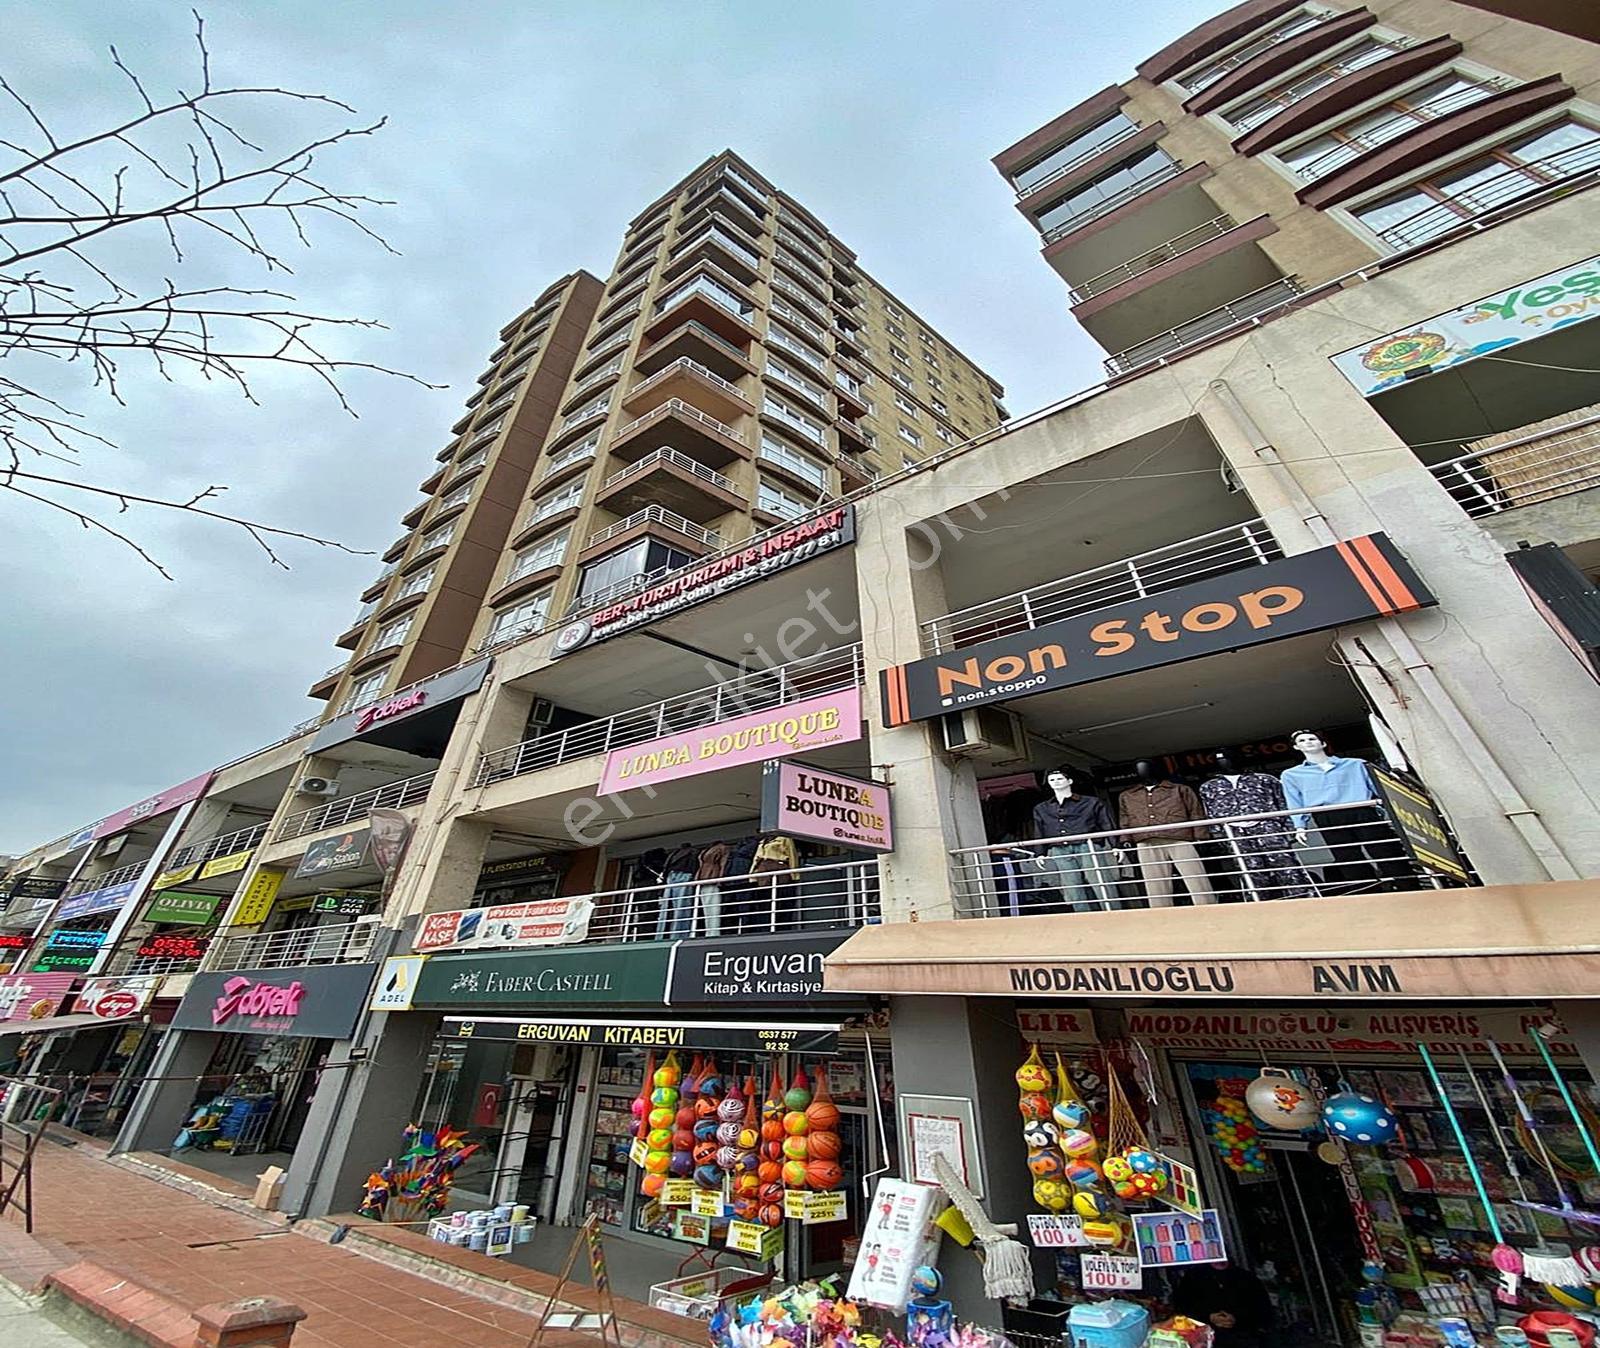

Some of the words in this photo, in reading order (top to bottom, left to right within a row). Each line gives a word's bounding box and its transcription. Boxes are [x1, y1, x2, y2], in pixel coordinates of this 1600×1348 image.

[743, 547, 760, 565] &
[761, 509, 846, 556] İNŞAAT
[718, 566, 758, 588] 0532
[817, 531, 841, 547] 81
[936, 642, 1067, 697] Non
[1088, 583, 1305, 659] Stop
[618, 743, 694, 780] LUNEA
[698, 706, 841, 761] BOUTIQUE
[797, 772, 875, 809] LUNEA
[785, 795, 886, 831] BOUTIQUE
[158, 897, 212, 911] OLIVIA
[154, 938, 198, 949] 0535
[703, 951, 824, 982] Erguvan
[1010, 960, 1234, 996] MODANLIOĞLU
[1312, 964, 1402, 995] AVM
[485, 968, 613, 993] FABER-CASTELL
[704, 982, 739, 996] Kitap
[741, 981, 753, 994] &
[756, 979, 822, 996] Kırtasiye
[379, 994, 405, 1004] ADEL
[517, 1023, 591, 1042] ERGUVAN
[604, 1025, 684, 1046] KİTABEVİ
[758, 1030, 780, 1039] 0537
[780, 1030, 798, 1039] 577
[1129, 1012, 1337, 1036] MODANLIOĞLU
[1368, 1011, 1481, 1038] ALIŞVERİŞ
[765, 1042, 777, 1051] 92
[777, 1042, 790, 1051] 32
[1029, 1216, 1060, 1229] FUTBOL
[1059, 1215, 1081, 1229] TOPU
[1033, 1230, 1064, 1245] 100
[1086, 1271, 1117, 1286] 100
[1120, 1261, 1139, 1274] TOPU
